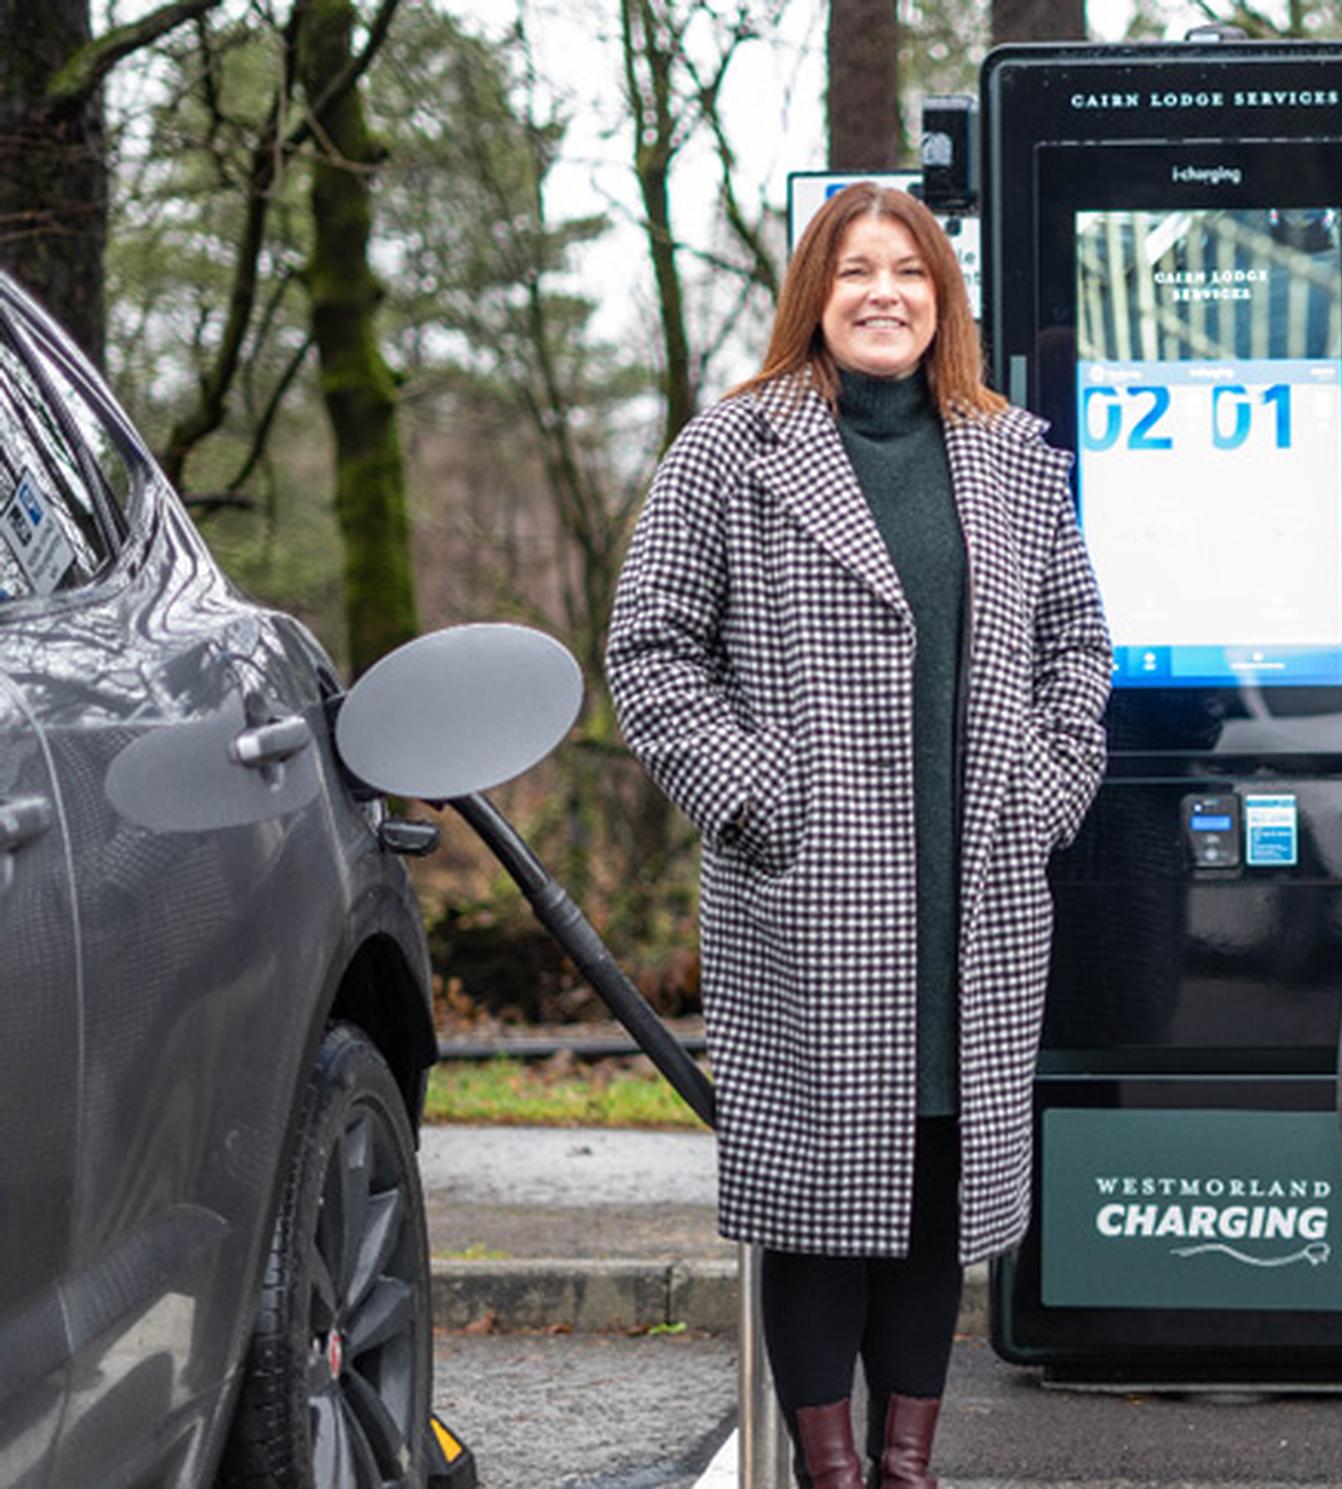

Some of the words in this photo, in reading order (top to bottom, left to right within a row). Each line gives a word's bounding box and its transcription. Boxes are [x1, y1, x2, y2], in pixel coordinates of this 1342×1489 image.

[1071, 93, 1139, 108] CAIRN
[1150, 92, 1224, 107] LODGE
[1234, 90, 1339, 106] SERVICES
[1172, 165, 1242, 184] i-charging
[1154, 271, 1205, 284] CAIRN
[1210, 270, 1269, 282] LODGE
[1172, 288, 1251, 301] SERVICES
[1083, 386, 1173, 451] 02
[1212, 384, 1291, 450] 01
[1096, 1178, 1331, 1198] WESTMORLAND
[1096, 1203, 1329, 1239] CHARGING
